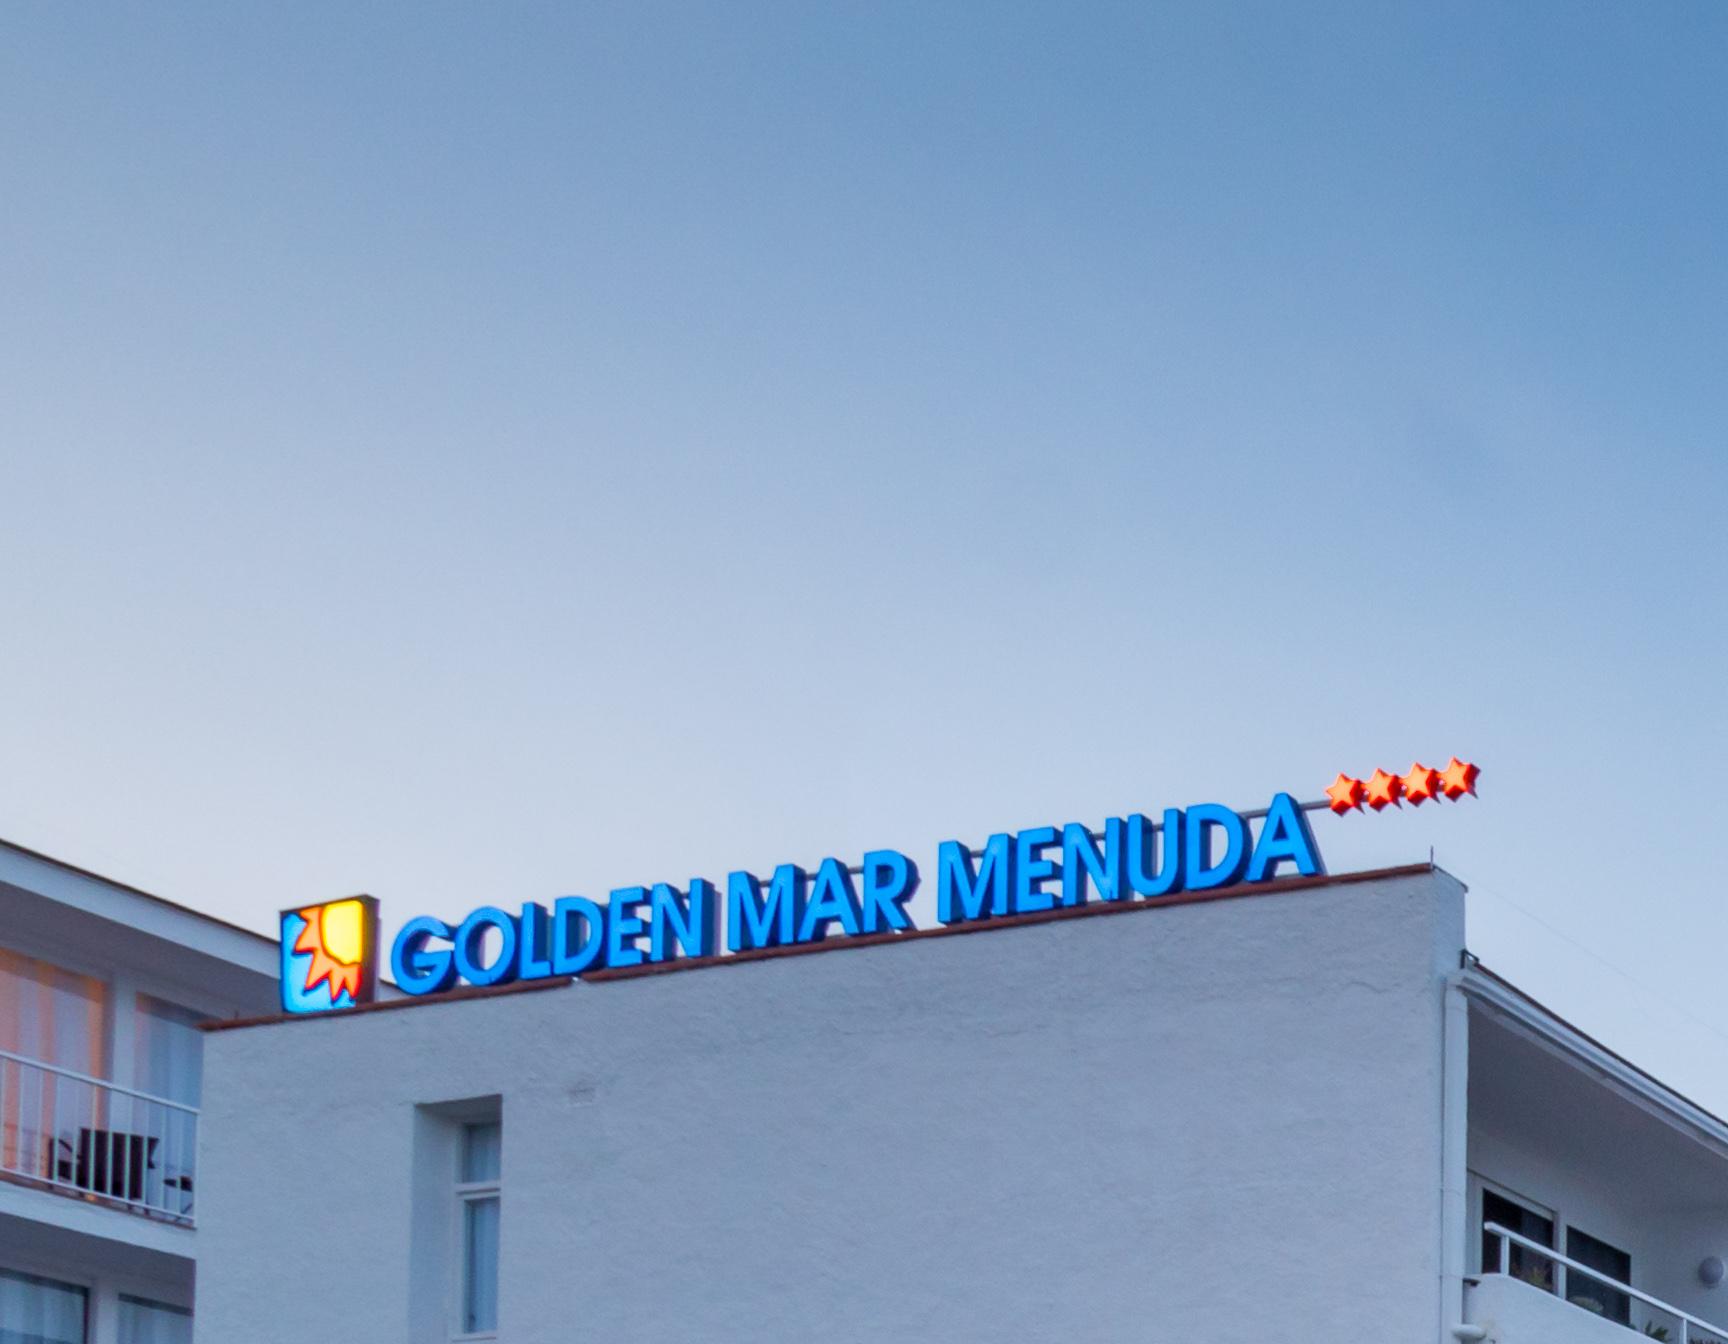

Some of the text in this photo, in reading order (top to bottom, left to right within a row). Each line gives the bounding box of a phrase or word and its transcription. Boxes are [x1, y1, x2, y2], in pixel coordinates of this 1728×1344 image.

[390, 792, 1324, 996] GOLDEN MAR MENUDA
